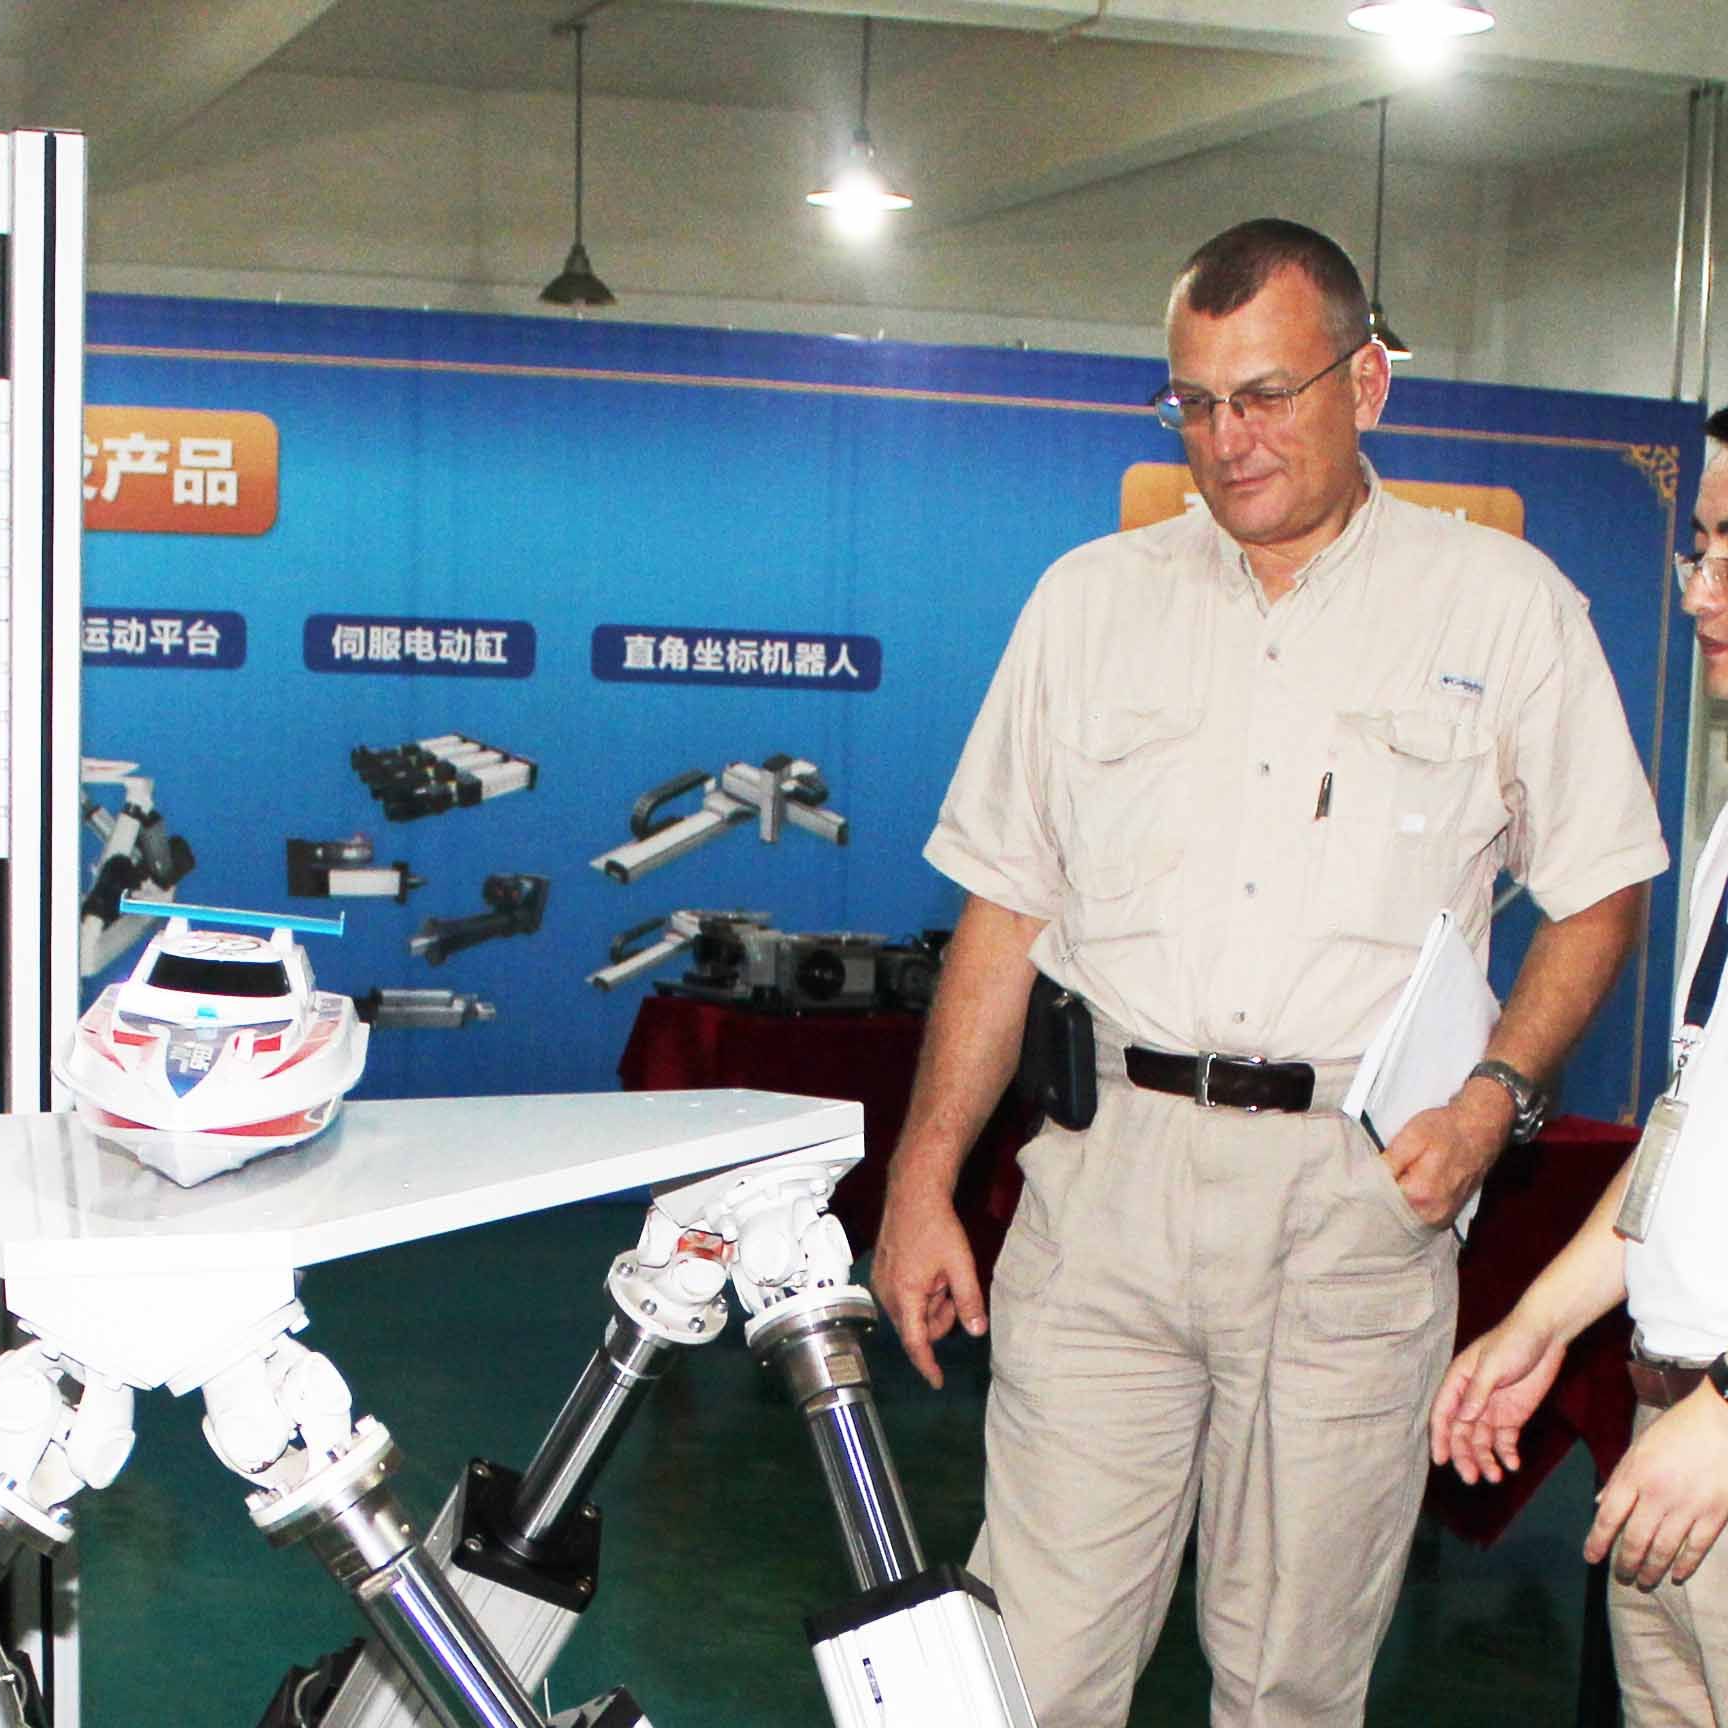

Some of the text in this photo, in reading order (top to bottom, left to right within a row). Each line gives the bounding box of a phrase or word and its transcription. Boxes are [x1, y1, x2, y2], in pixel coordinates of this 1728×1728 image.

[83, 432, 239, 506] 产品
[331, 623, 508, 665] 伺服电动缸
[622, 634, 860, 679] 直角坐标机器人
